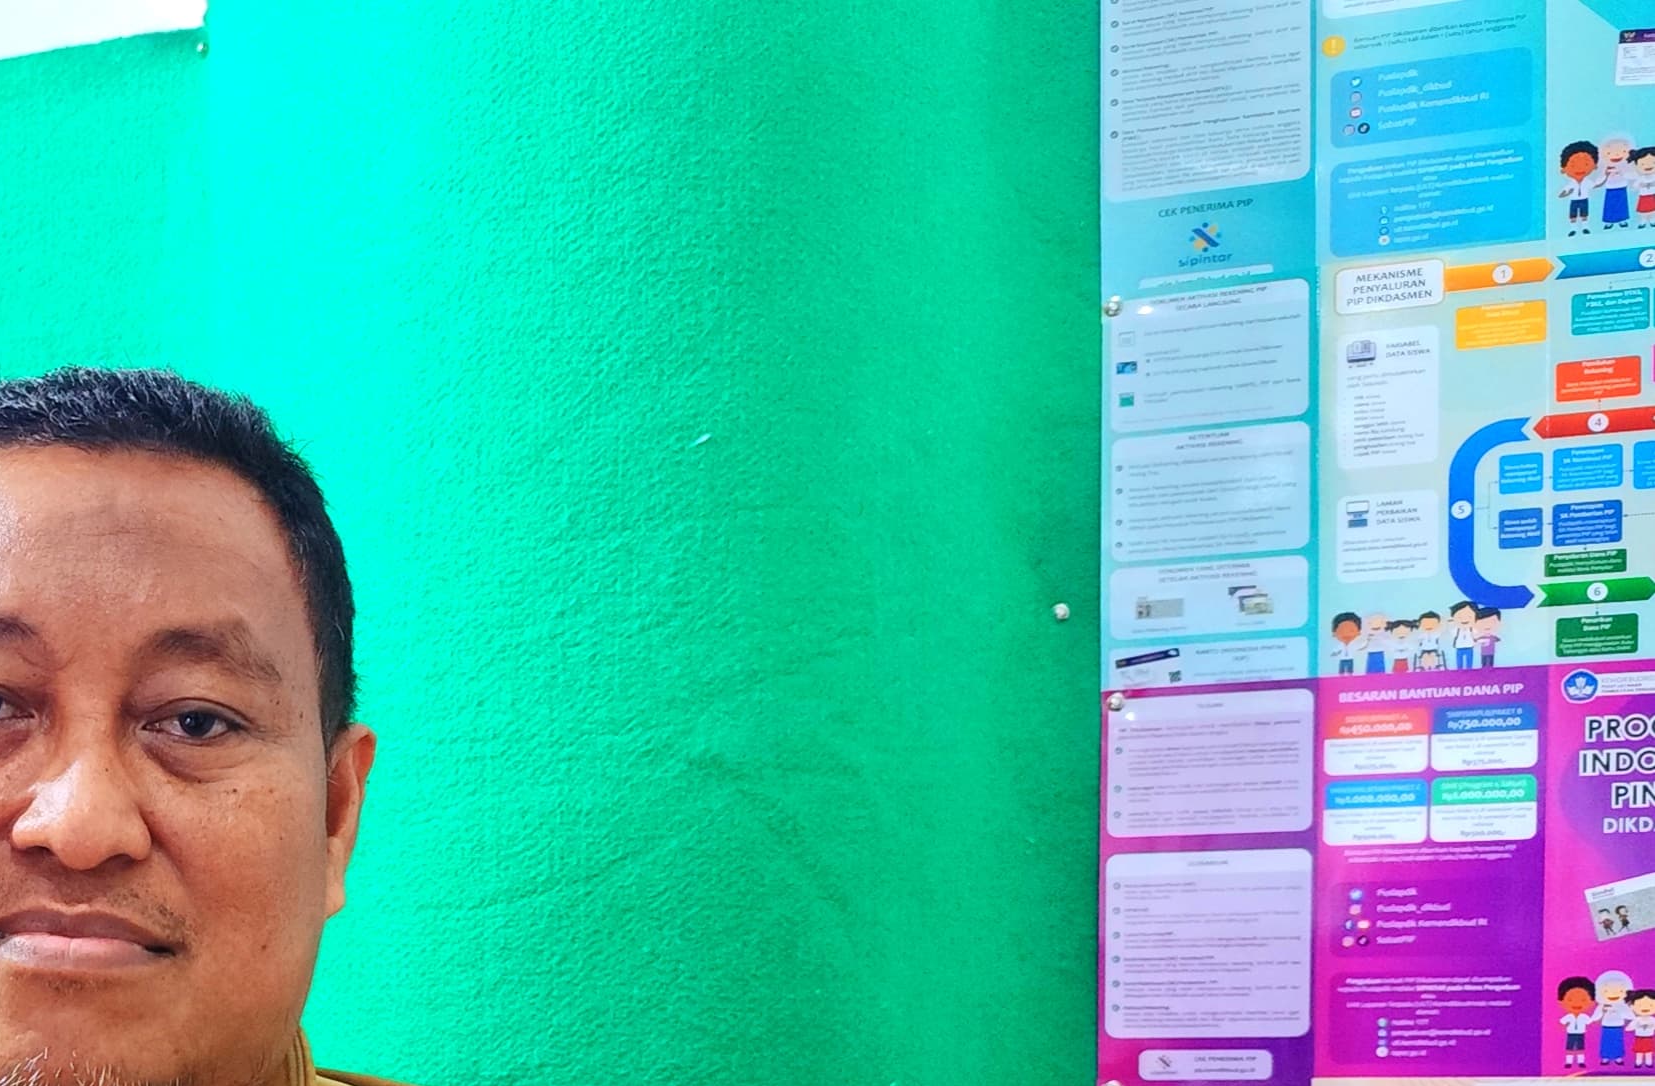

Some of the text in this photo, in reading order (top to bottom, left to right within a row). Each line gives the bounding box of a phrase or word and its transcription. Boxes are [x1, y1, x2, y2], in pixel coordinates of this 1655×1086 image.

[1158, 198, 1254, 218] CEK PENERIMA PIP
[1178, 253, 1233, 268] sipintar
[1356, 267, 1423, 283] MEKANISME
[1353, 279, 1426, 295] PENYALURAN
[1347, 289, 1433, 307] PIP DIKDASMEN
[1594, 418, 1601, 426] 4
[1458, 505, 1465, 514] 5
[1594, 587, 1601, 596] 6
[1339, 683, 1524, 703] BESARAN BANTUAN DANA PIP
[1585, 714, 1655, 742] PRO
[1603, 817, 1655, 833] DIKD
